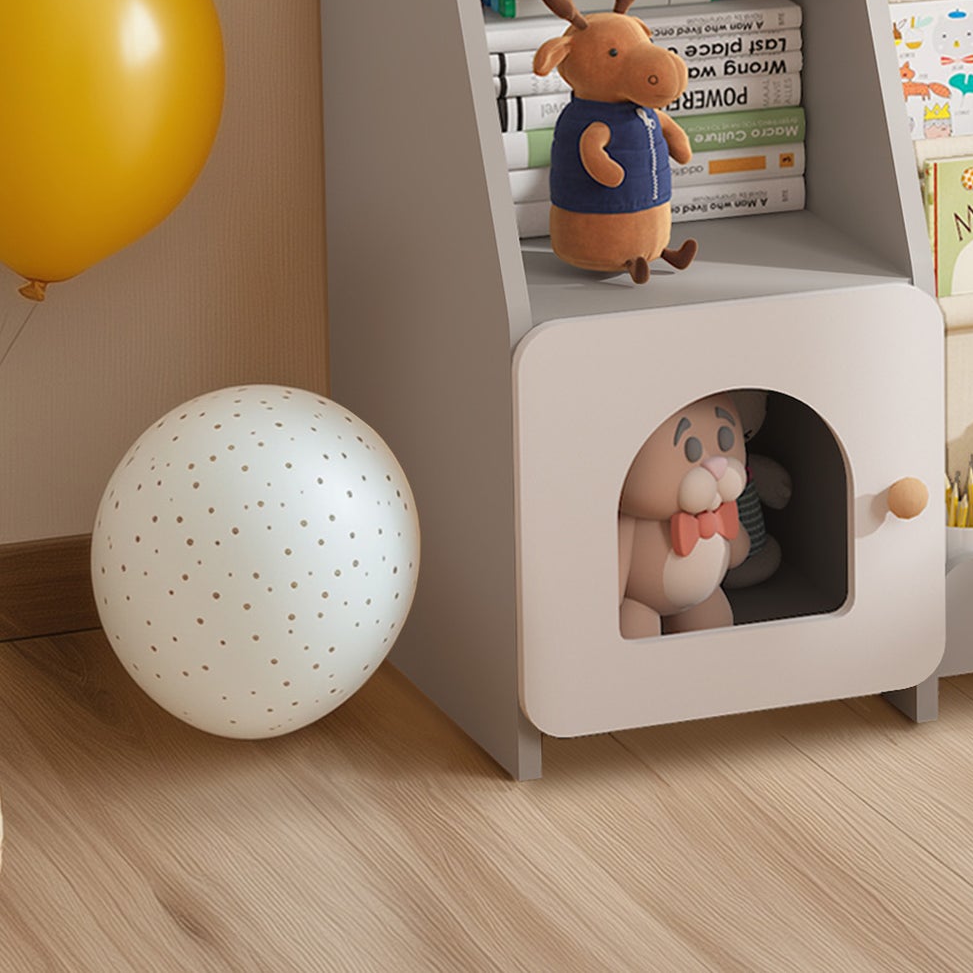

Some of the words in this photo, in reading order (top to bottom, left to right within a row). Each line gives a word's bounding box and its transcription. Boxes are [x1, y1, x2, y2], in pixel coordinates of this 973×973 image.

[704, 25, 728, 34] who
[729, 22, 753, 31] Man
[756, 21, 764, 29] A
[677, 26, 703, 37] lived
[685, 37, 742, 57] place
[749, 37, 786, 53] Last
[724, 60, 786, 77] Wrong
[694, 129, 747, 143] Culture
[751, 125, 799, 138] Macro
[710, 202, 732, 212] who
[734, 199, 758, 208] Man
[760, 198, 768, 207] A
[682, 204, 708, 215] lived
